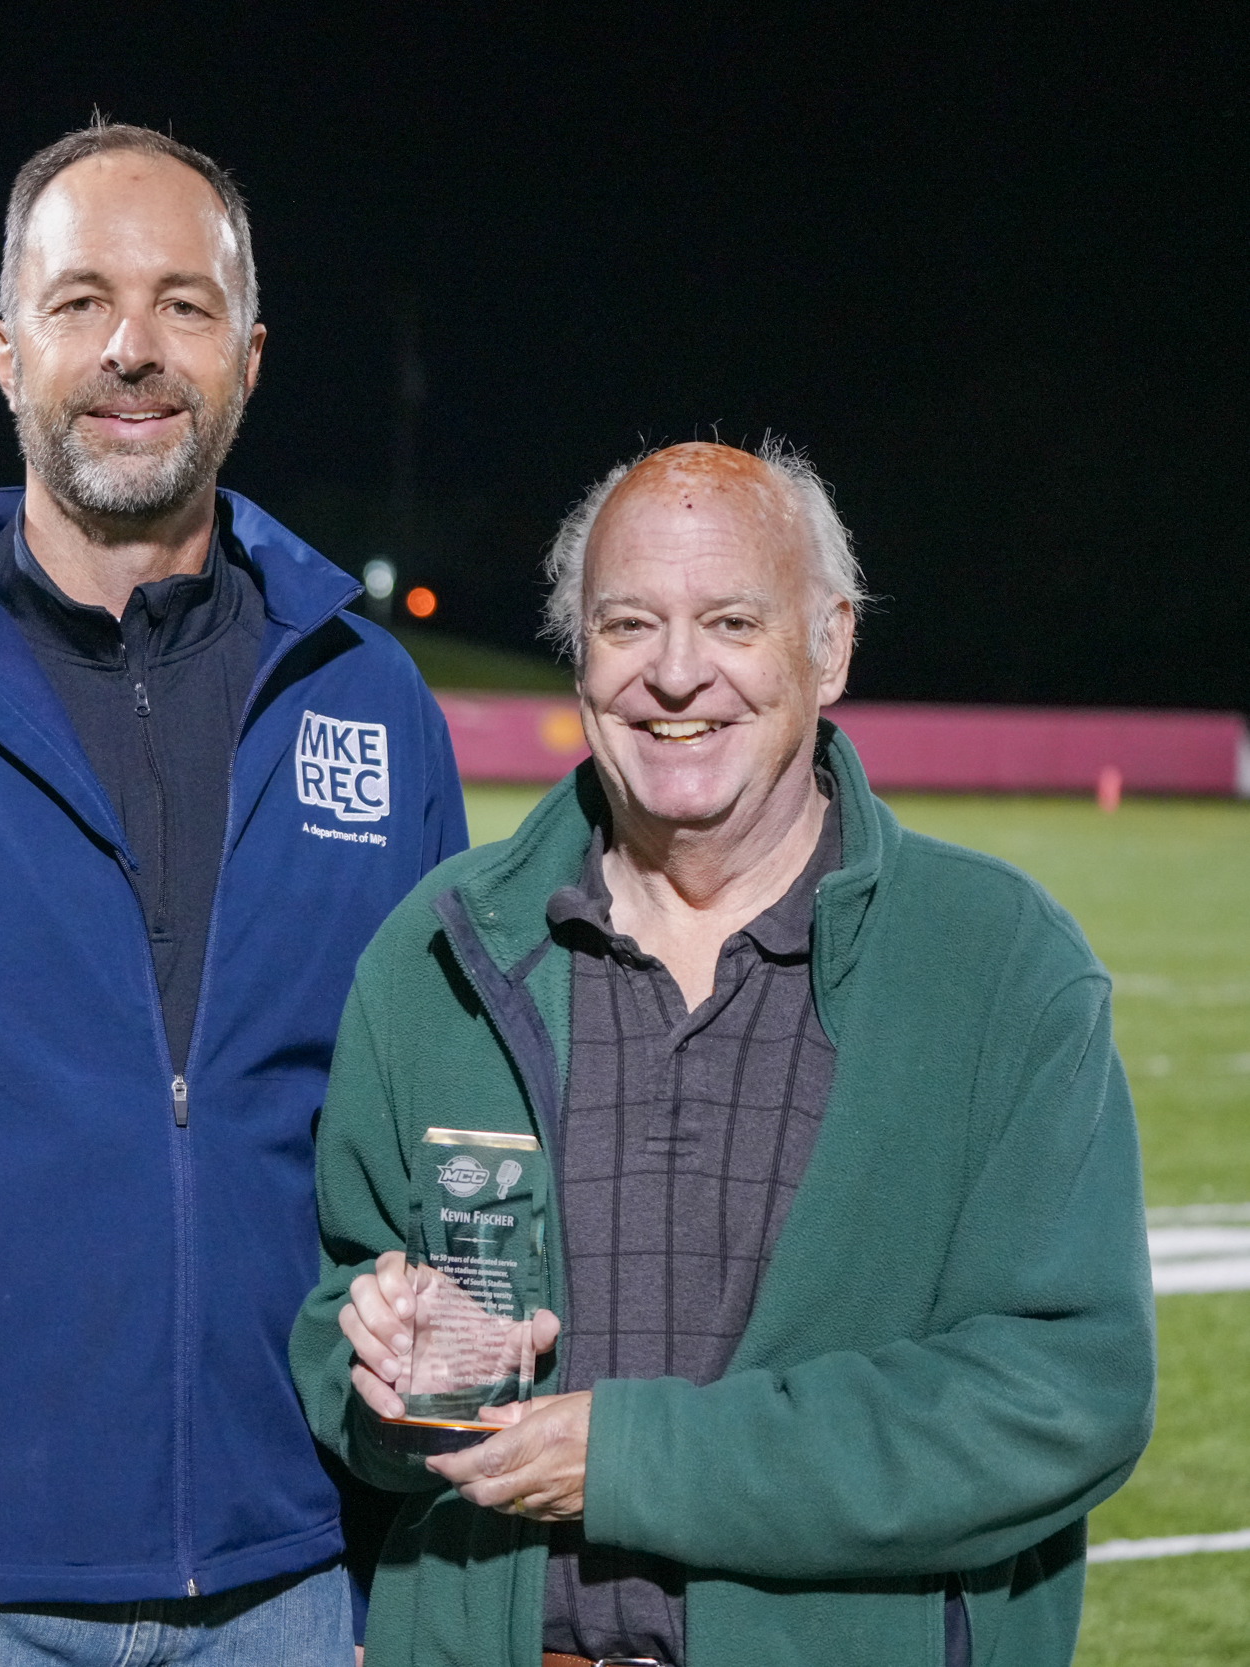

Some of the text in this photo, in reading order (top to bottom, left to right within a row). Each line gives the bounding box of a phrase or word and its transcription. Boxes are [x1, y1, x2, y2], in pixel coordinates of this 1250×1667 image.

[301, 717, 381, 767] MKE
[301, 761, 384, 812] REC
[302, 822, 388, 848] A department of MPS
[442, 1168, 487, 1185] MCC
[430, 1253, 439, 1261] For
[440, 1254, 447, 1262] 50
[470, 1257, 497, 1266] dedicated
[454, 1267, 477, 1275] stadium
[478, 1269, 509, 1278] announcer,
[470, 1278, 487, 1287] South
[487, 1280, 513, 1289] Stadium.
[494, 1292, 513, 1300] varsity
[498, 1303, 514, 1311] game
[464, 1375, 475, 1386] 10,
